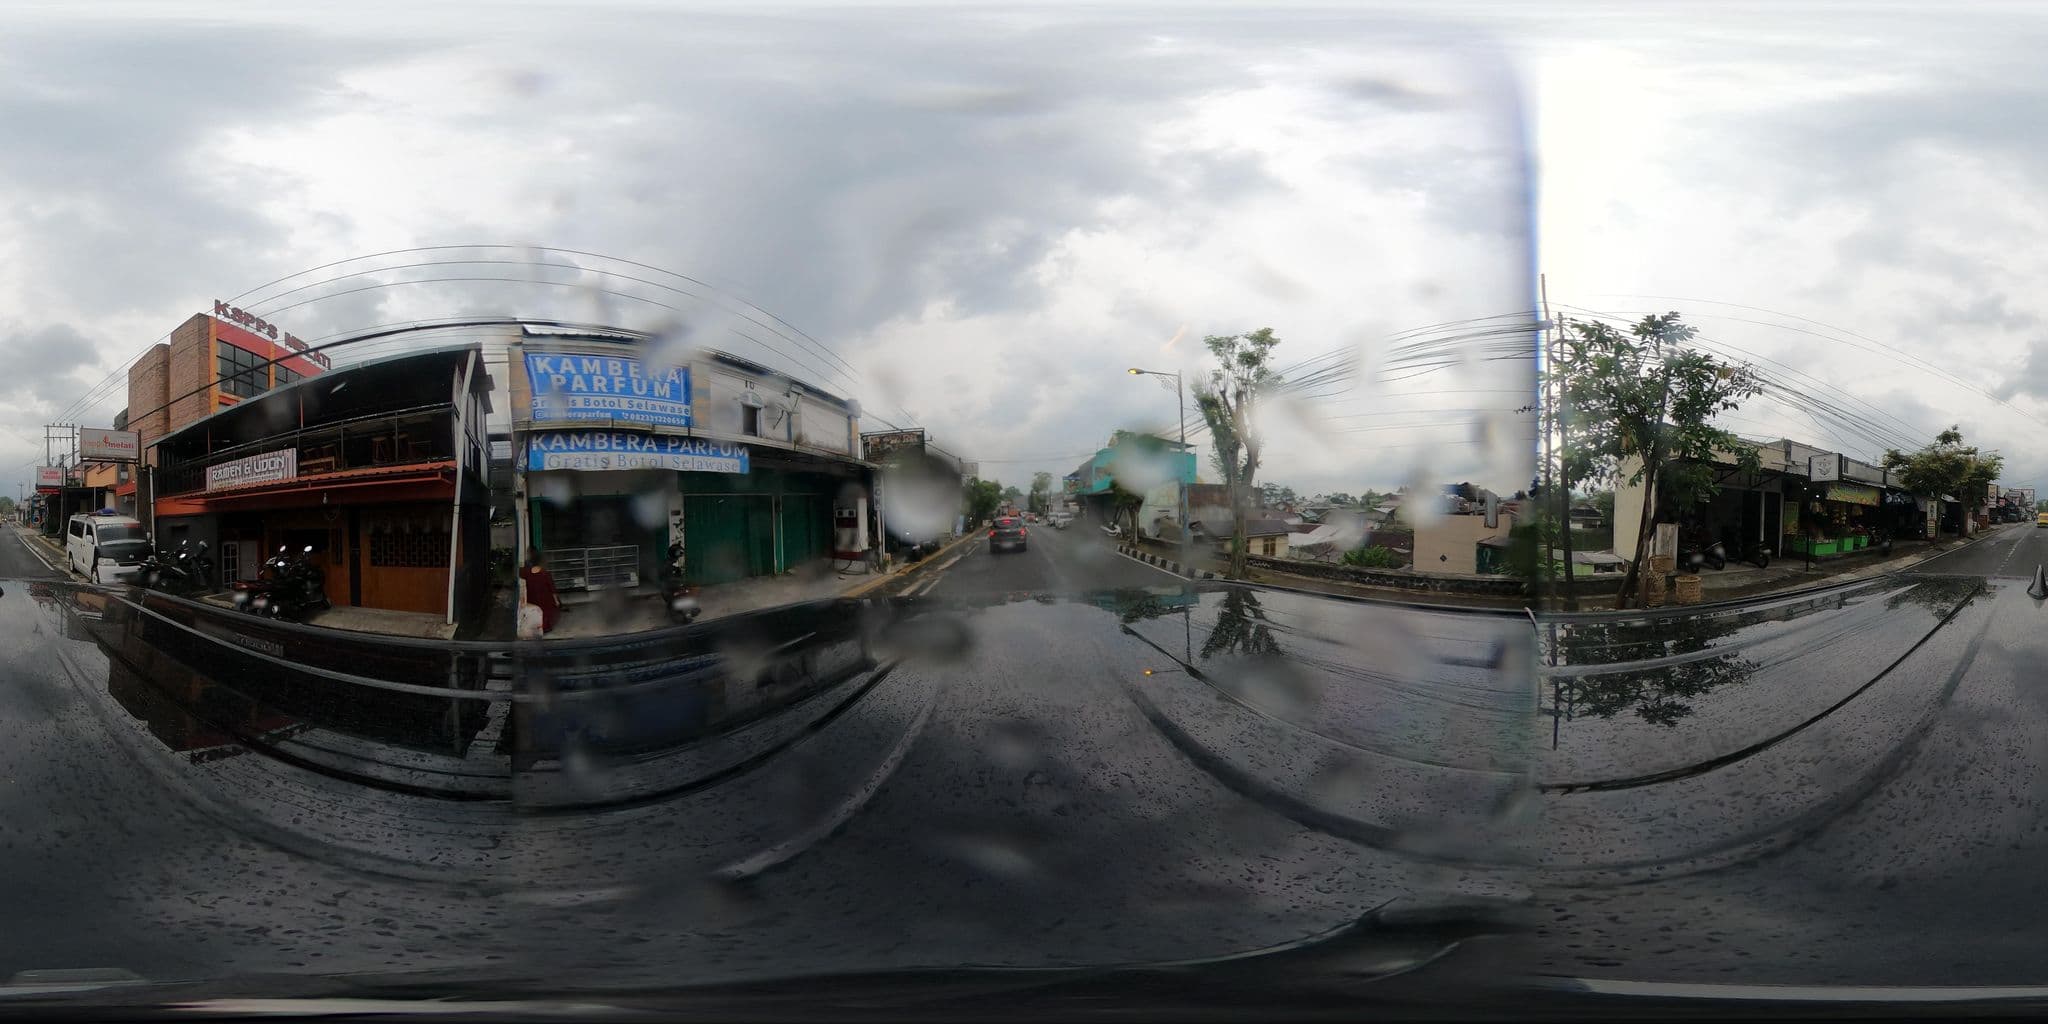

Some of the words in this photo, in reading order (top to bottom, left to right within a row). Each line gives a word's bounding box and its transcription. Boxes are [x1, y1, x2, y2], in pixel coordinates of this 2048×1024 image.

[215, 299, 278, 340] KSPPS
[535, 356, 680, 384] KAMBERA
[550, 374, 671, 398] PARFUM
[532, 397, 577, 408] Gris
[583, 397, 622, 409] Botol
[627, 399, 690, 416] Selawase
[545, 409, 612, 420] eraparfum
[108, 440, 134, 450] melati
[532, 432, 657, 451] KAMBERA
[667, 438, 749, 458] PARFUM
[212, 464, 242, 480] RAMEN
[253, 456, 285, 473] UDON
[547, 453, 609, 469] Gratis
[617, 454, 665, 469] Botol
[672, 456, 738, 472] Selawase
